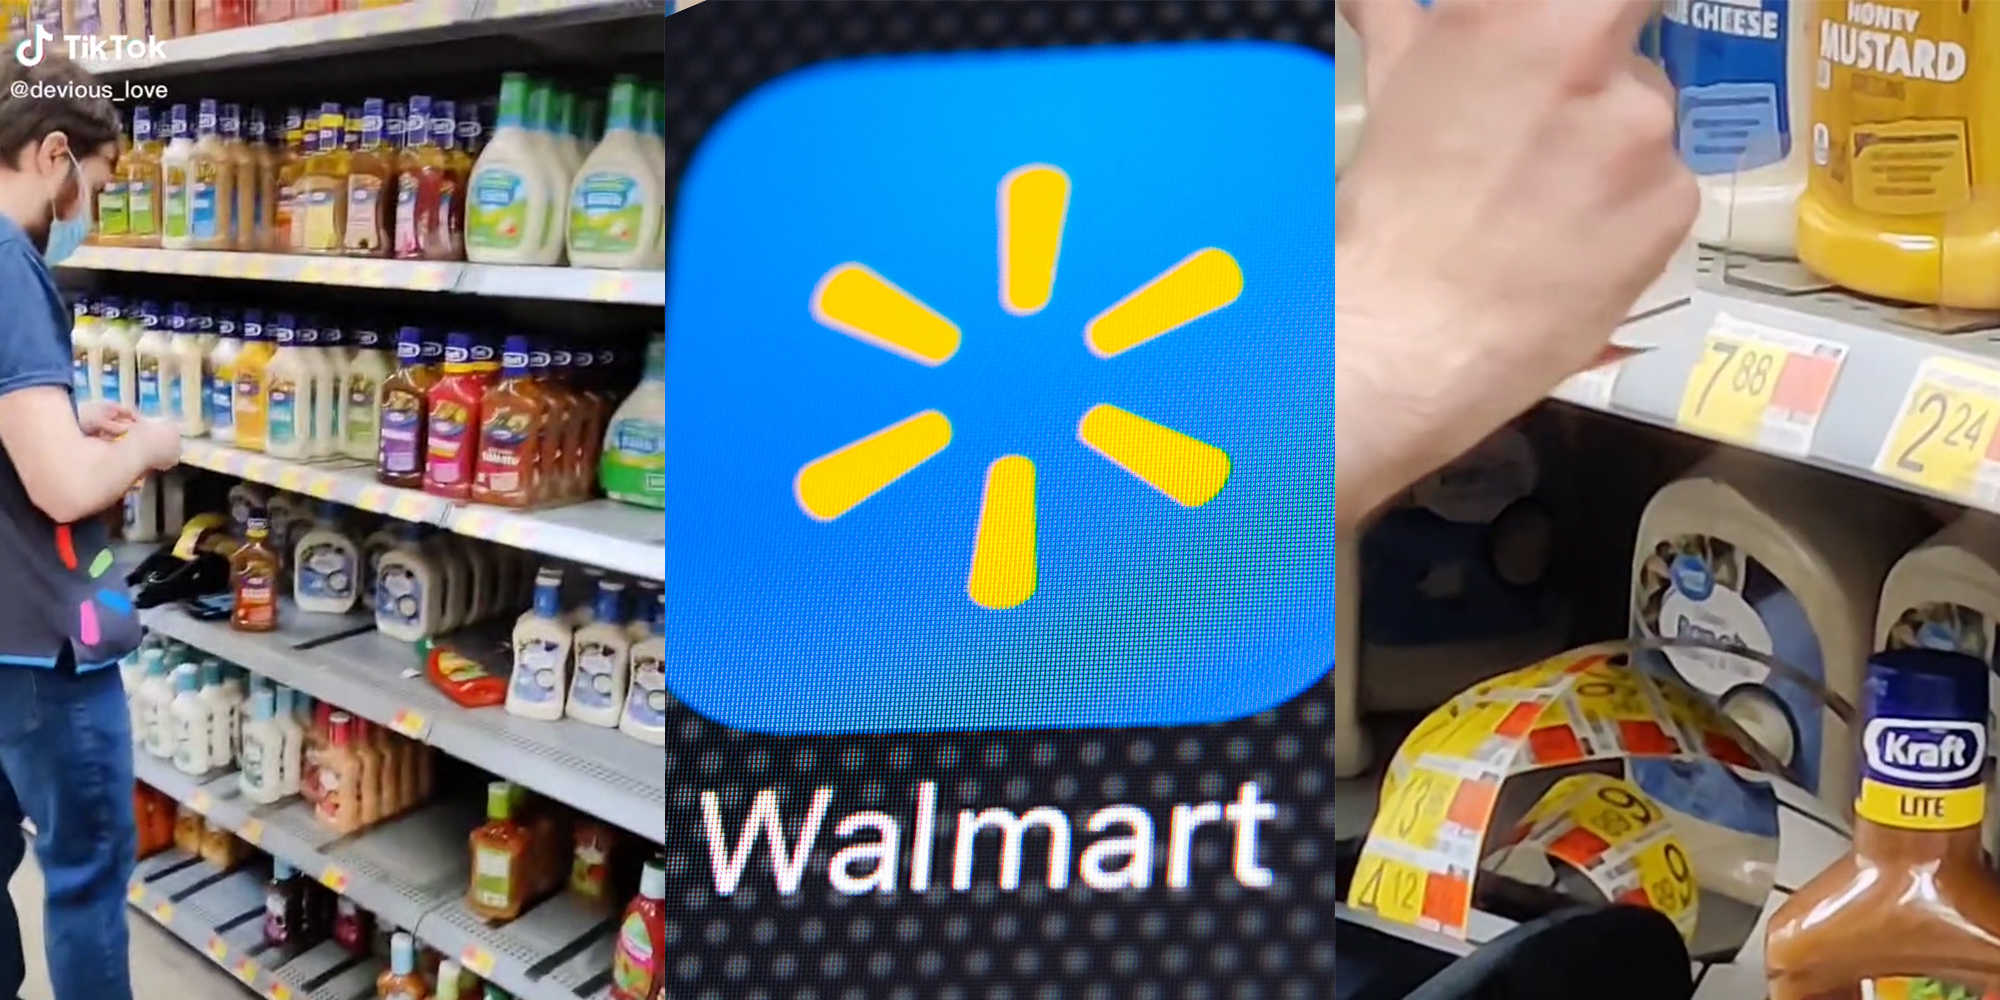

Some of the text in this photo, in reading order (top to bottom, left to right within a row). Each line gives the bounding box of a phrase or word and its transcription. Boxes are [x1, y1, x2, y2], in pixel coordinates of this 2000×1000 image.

[1691, 2, 1779, 39] CHEESE
[1847, 1, 1921, 33] HONEY
[1820, 18, 1967, 82] MUSTARD
[1885, 731, 1966, 767] Kraft
[1900, 794, 1945, 817] LITE
[700, 781, 1276, 896] Walmart
